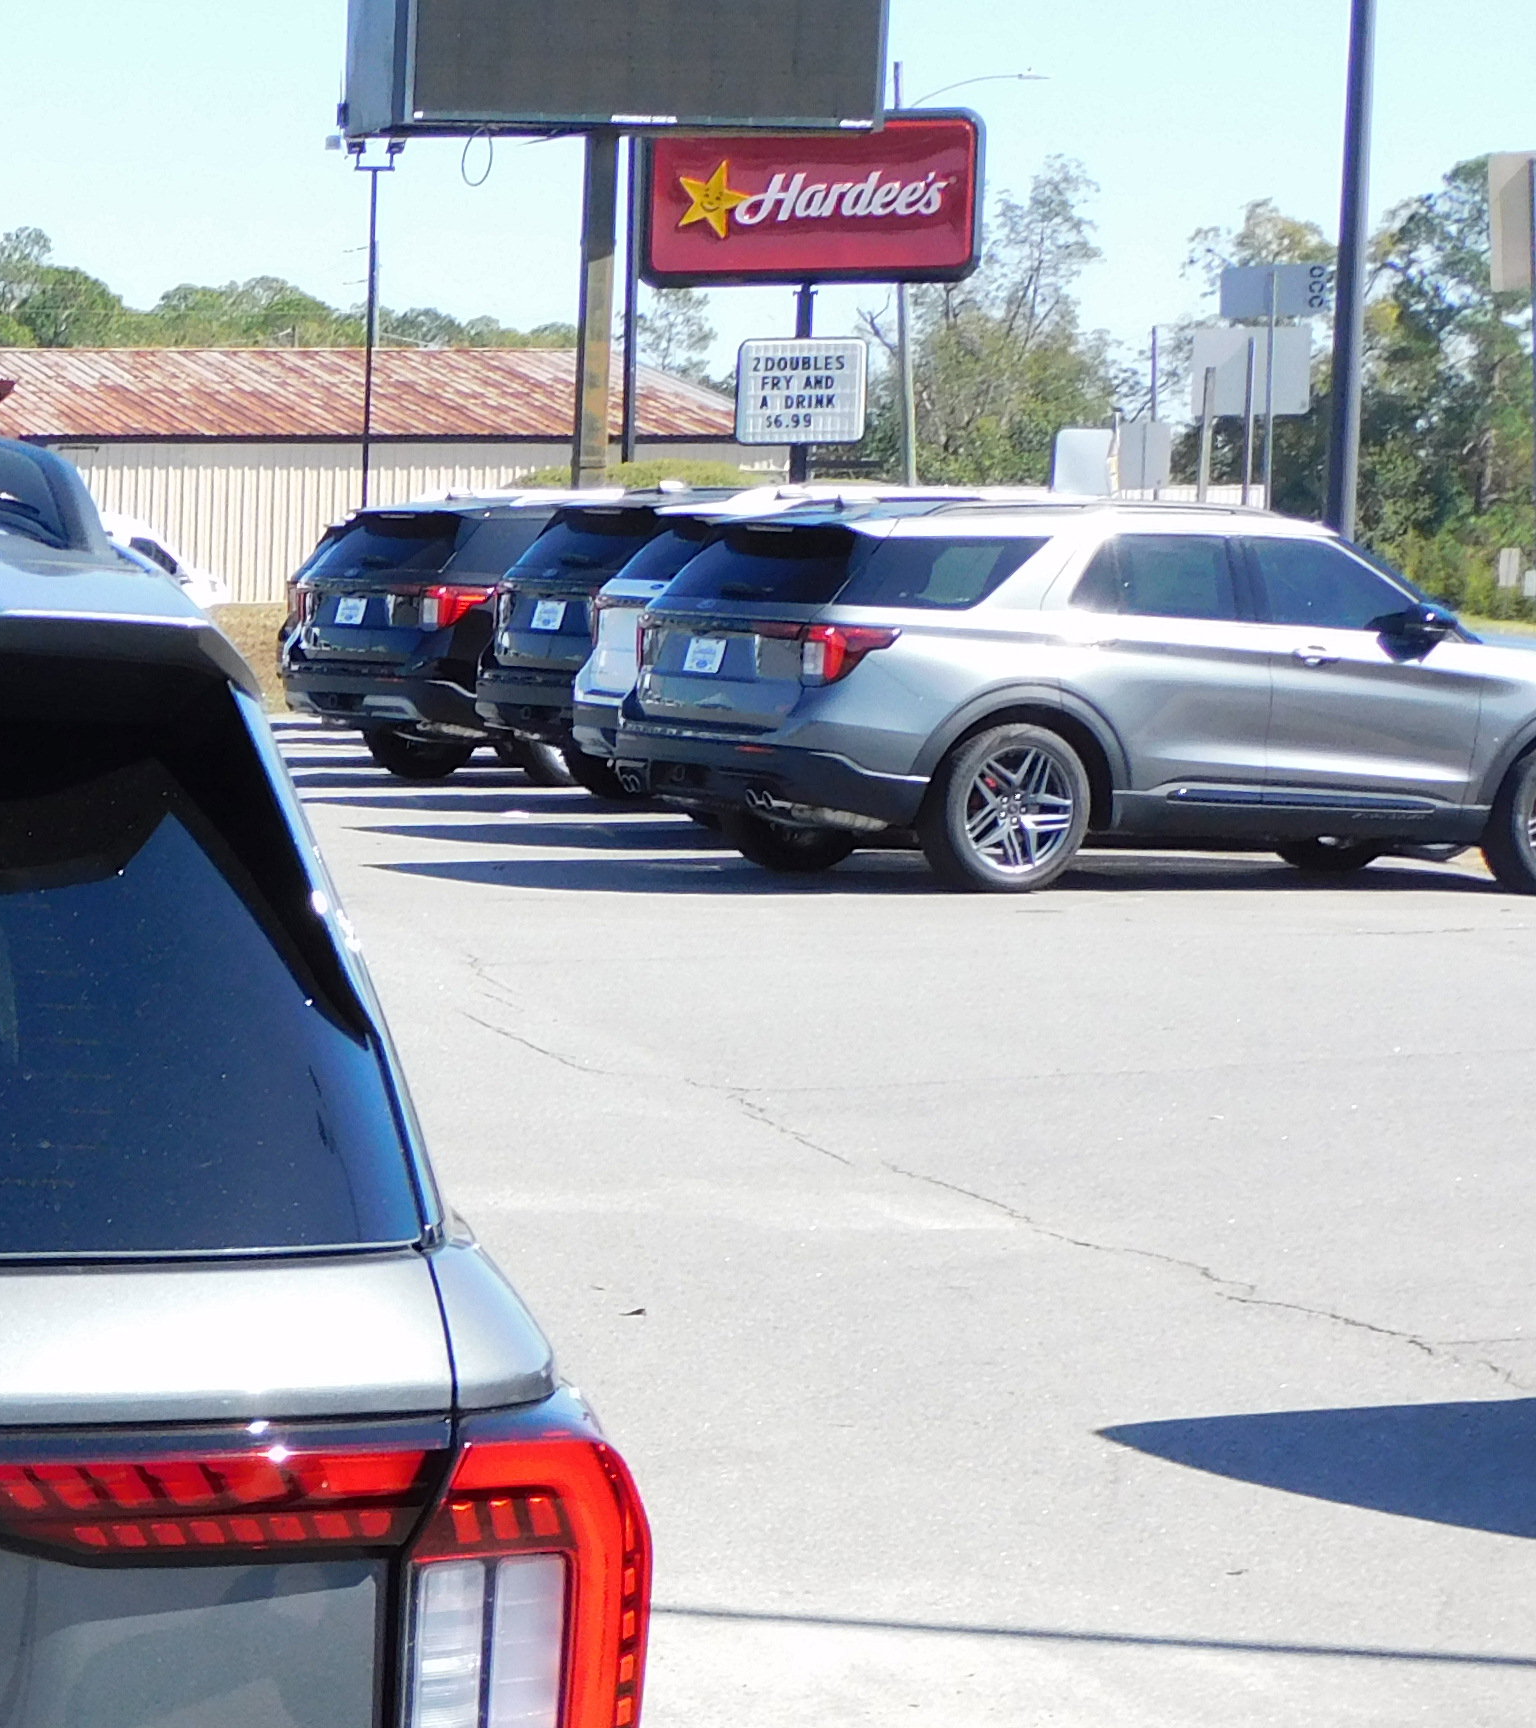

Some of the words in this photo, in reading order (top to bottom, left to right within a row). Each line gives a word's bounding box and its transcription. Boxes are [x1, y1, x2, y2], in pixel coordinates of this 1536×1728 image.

[734, 169, 948, 225] Hardee's
[760, 375, 794, 391] FRY
[803, 375, 835, 390] AND
[759, 394, 769, 409] A
[784, 394, 836, 409] DRINK
